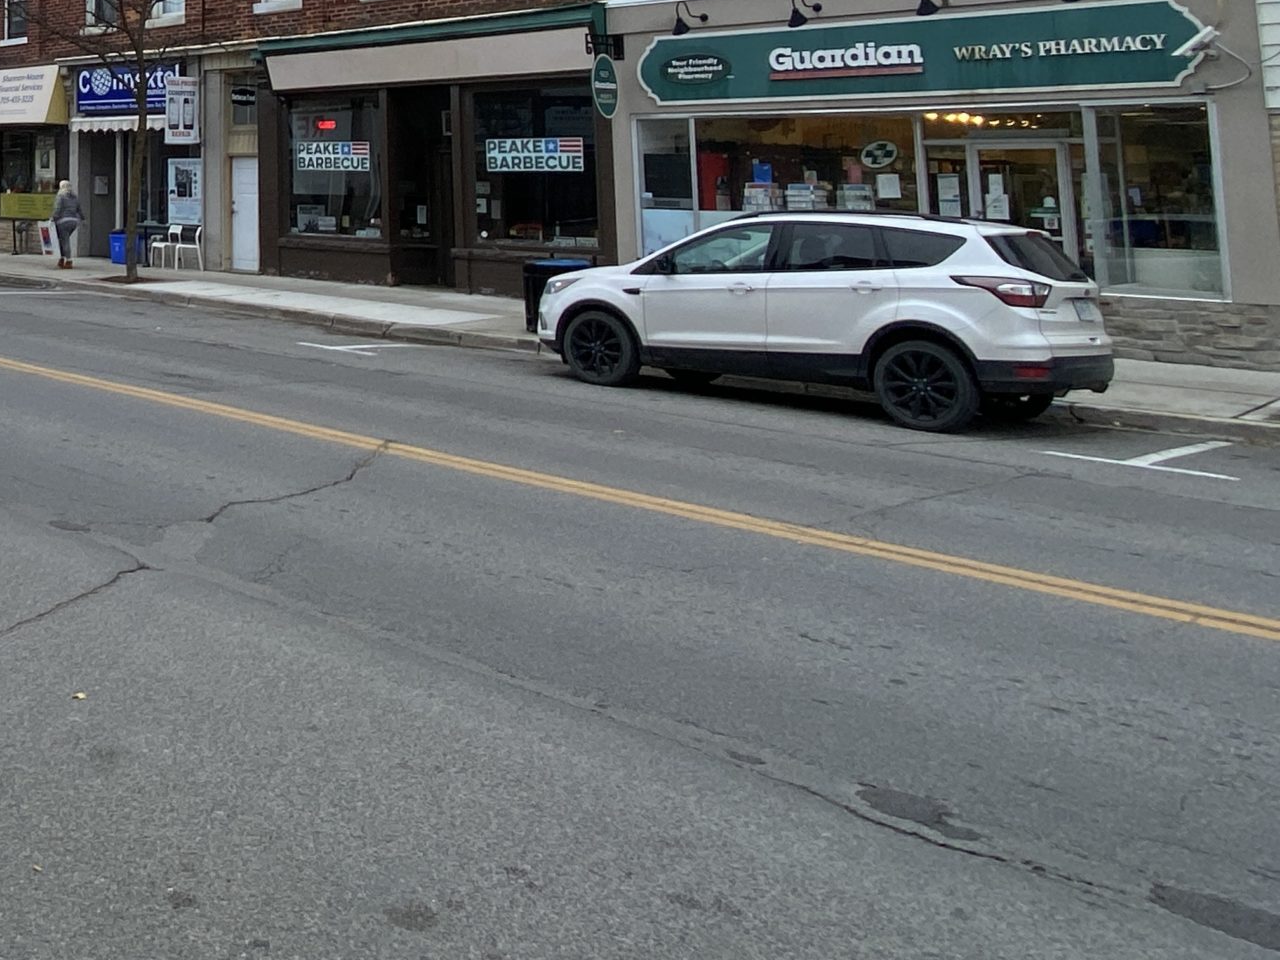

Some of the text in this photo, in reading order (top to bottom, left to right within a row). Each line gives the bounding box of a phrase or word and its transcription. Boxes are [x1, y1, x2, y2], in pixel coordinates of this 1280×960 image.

[769, 33, 1166, 71] Guardian WRAY'S PHARMACY
[298, 143, 340, 155] PEAKE
[487, 140, 543, 154] PEAKE
[298, 157, 369, 170] BARBECUE
[487, 155, 583, 170] BARBECUE
